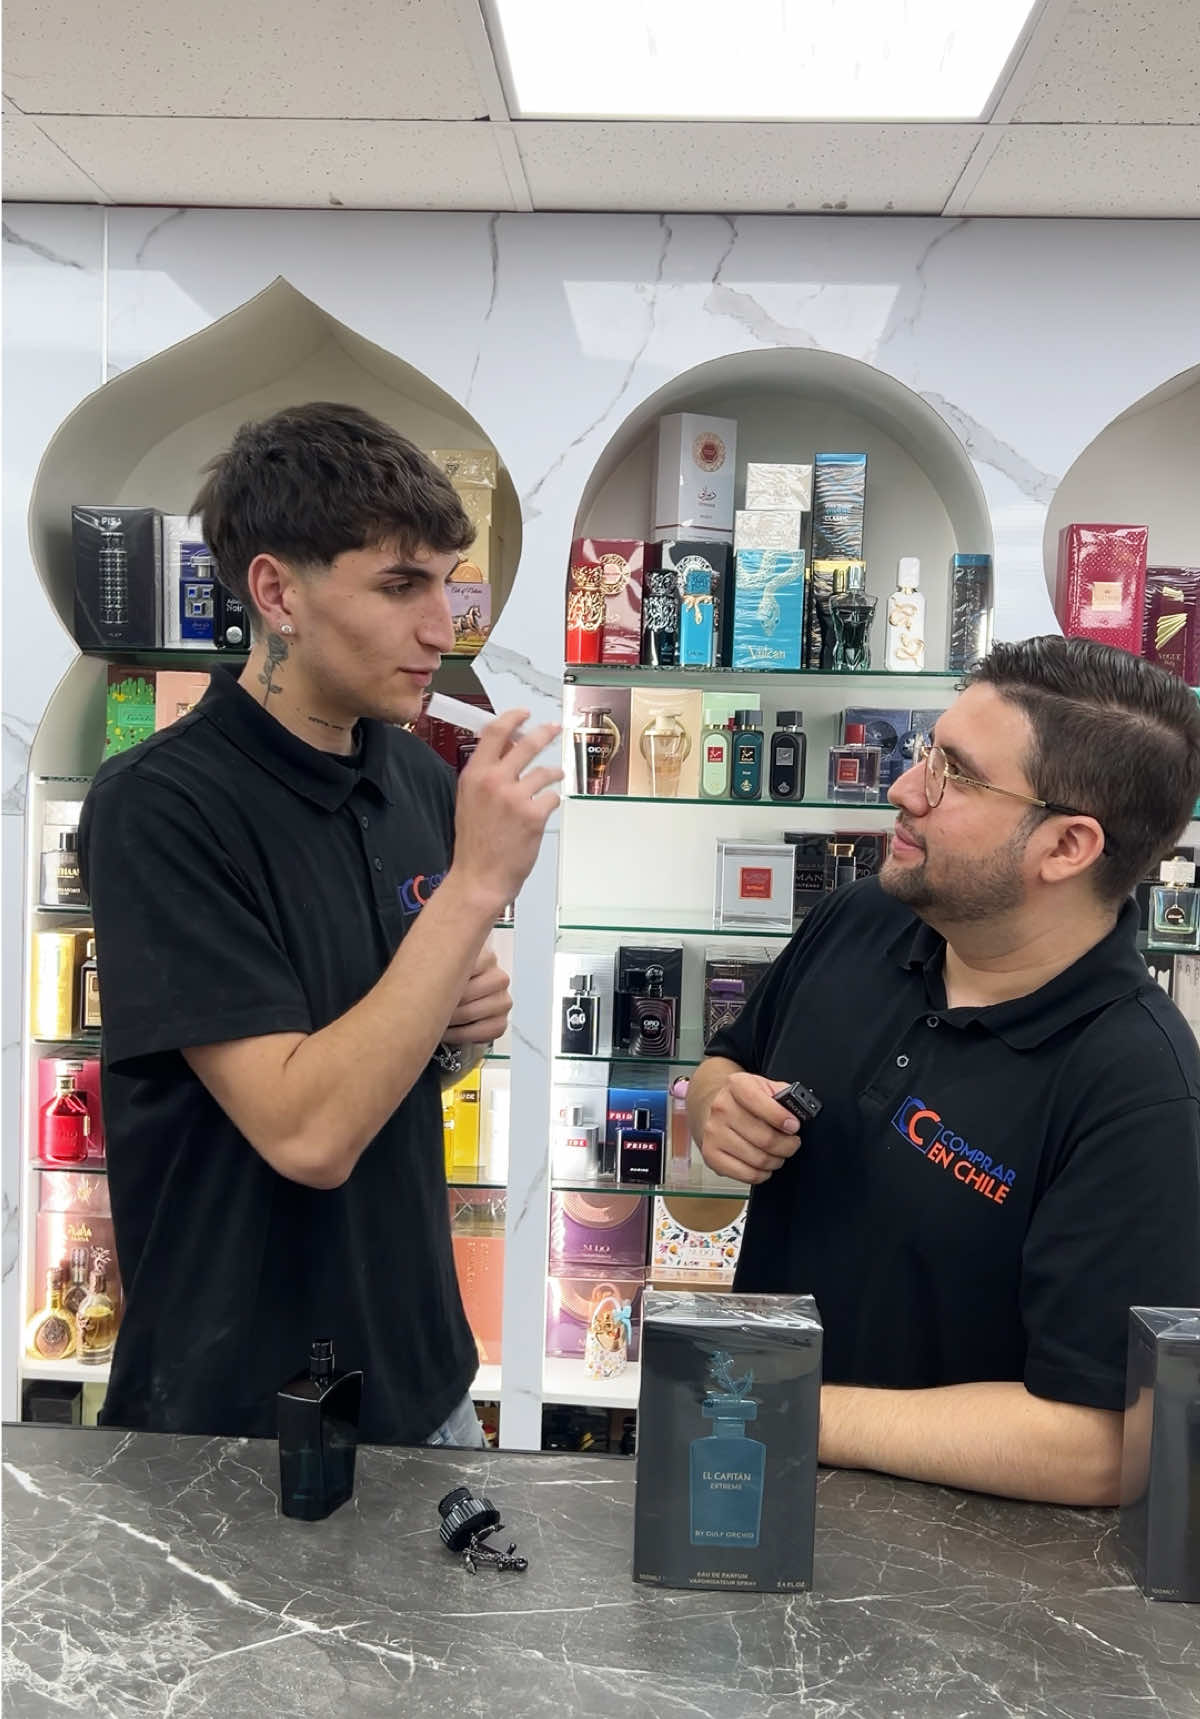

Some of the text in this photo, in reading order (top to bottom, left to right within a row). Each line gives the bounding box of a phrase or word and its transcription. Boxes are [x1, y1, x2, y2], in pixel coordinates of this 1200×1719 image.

[609, 1111, 633, 1120] PRID
[626, 1142, 655, 1150] PRIDE
[940, 1129, 1017, 1186] COMPRAR
[927, 1141, 1011, 1205] EN CHILE
[702, 1471, 752, 1481] EL CAPITAN
[721, 1572, 749, 1580] PARFUM
